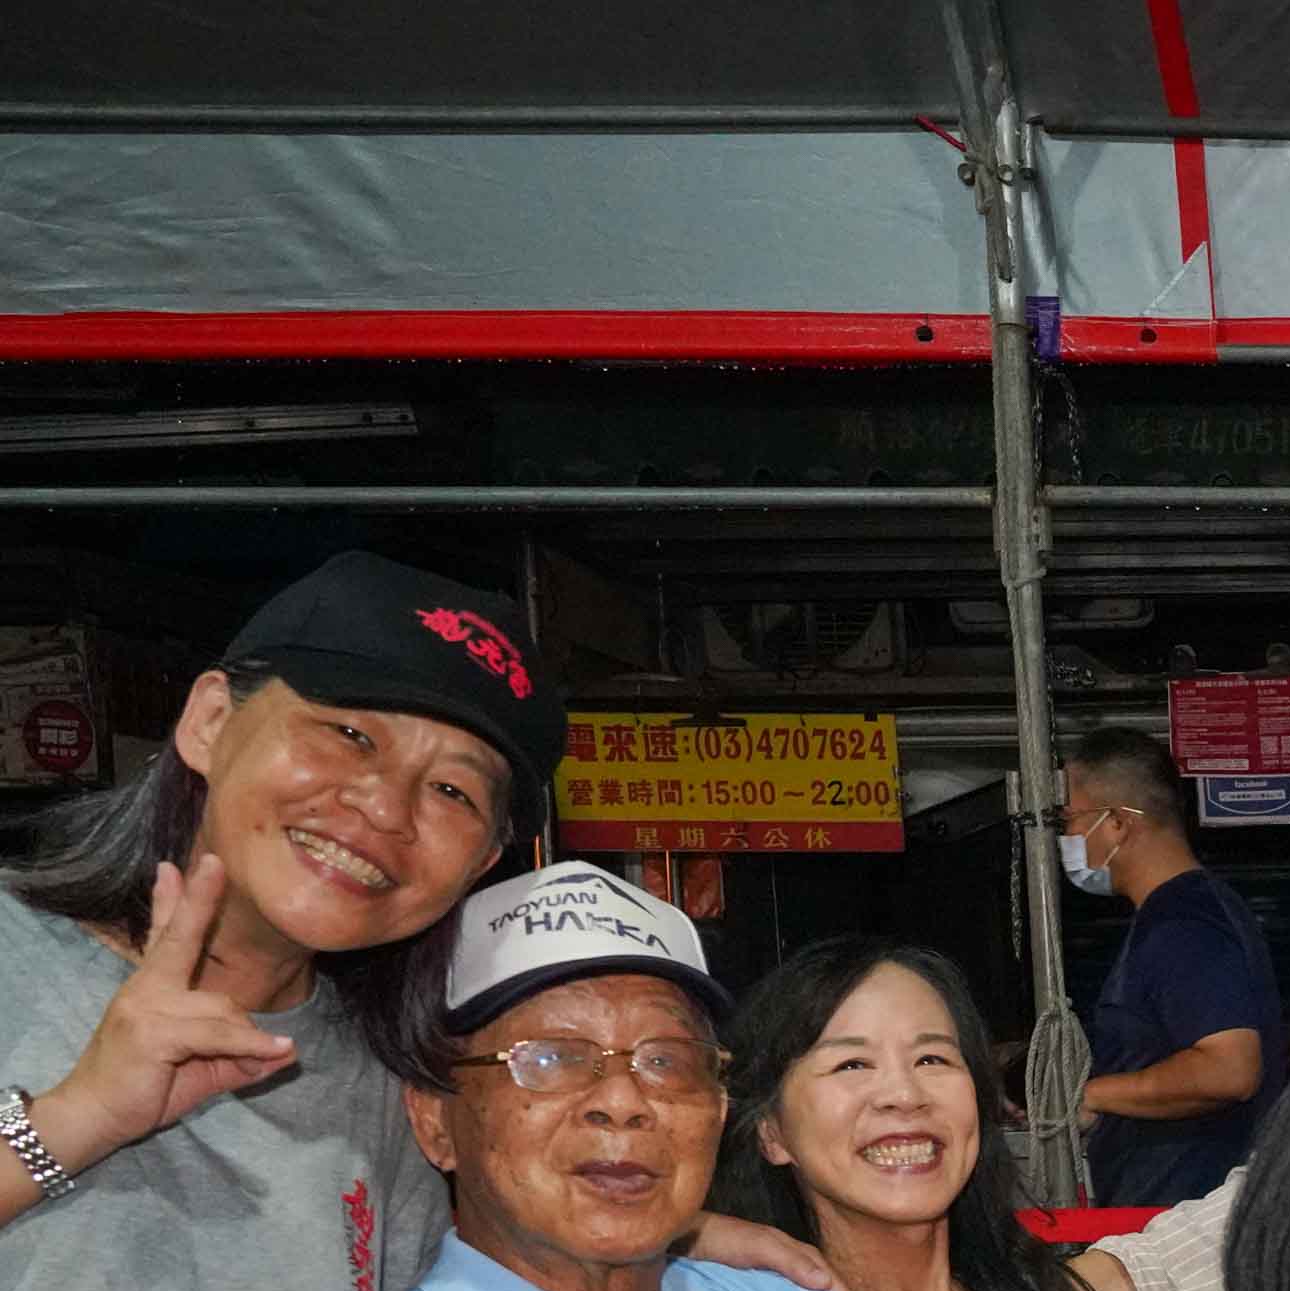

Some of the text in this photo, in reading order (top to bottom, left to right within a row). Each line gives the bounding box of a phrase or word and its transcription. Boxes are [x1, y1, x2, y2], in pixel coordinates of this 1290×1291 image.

[635, 827, 833, 850] 星期六公休
[488, 891, 598, 933] TAOYUAN
[524, 910, 673, 957] HAKKA
